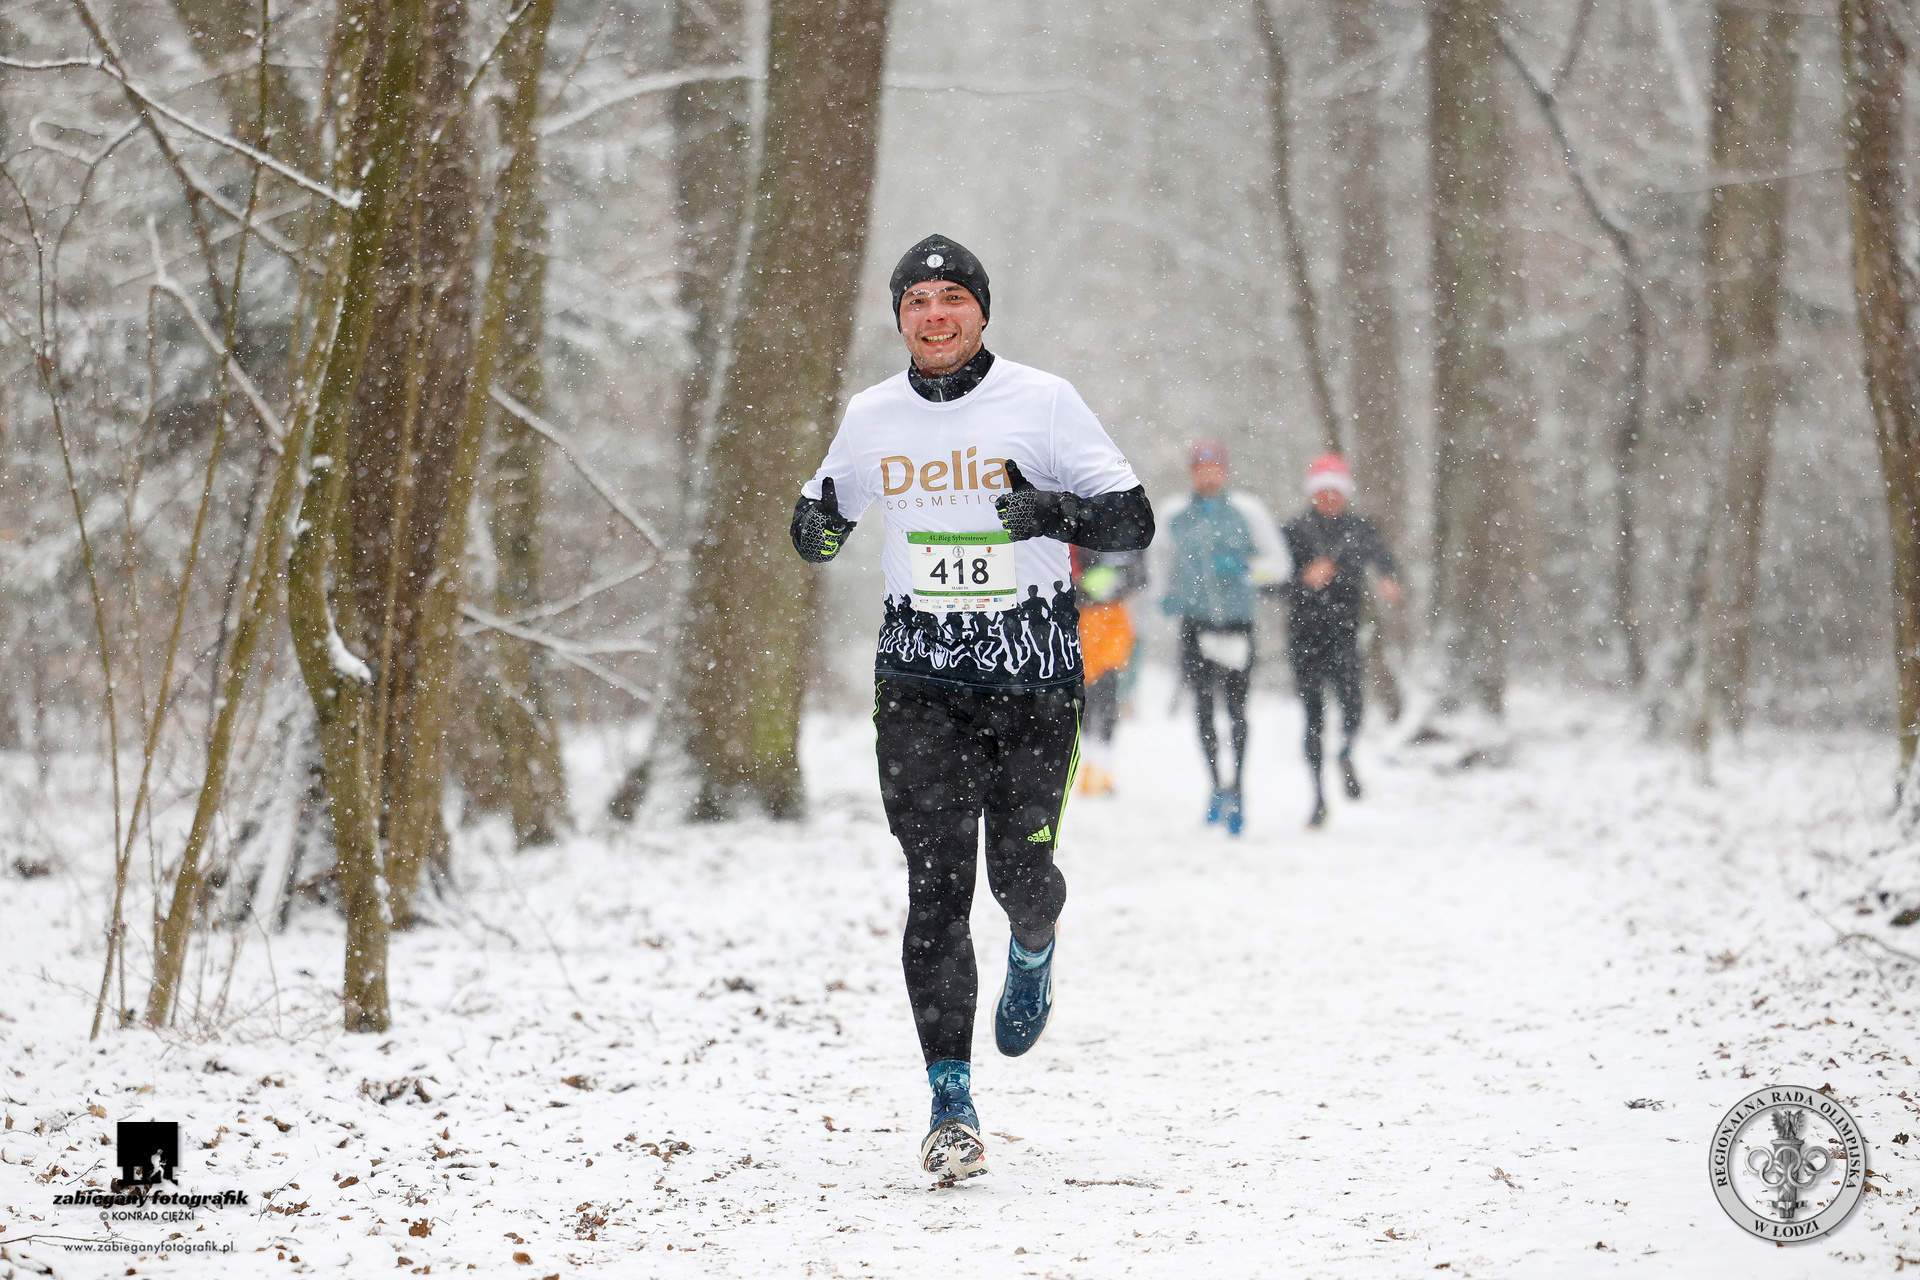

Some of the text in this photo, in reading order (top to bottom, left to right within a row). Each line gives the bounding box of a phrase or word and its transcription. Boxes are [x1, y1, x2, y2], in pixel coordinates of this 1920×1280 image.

[881, 446, 1012, 496] Delia
[887, 493, 998, 511] COSMETIC
[930, 558, 989, 584] 418
